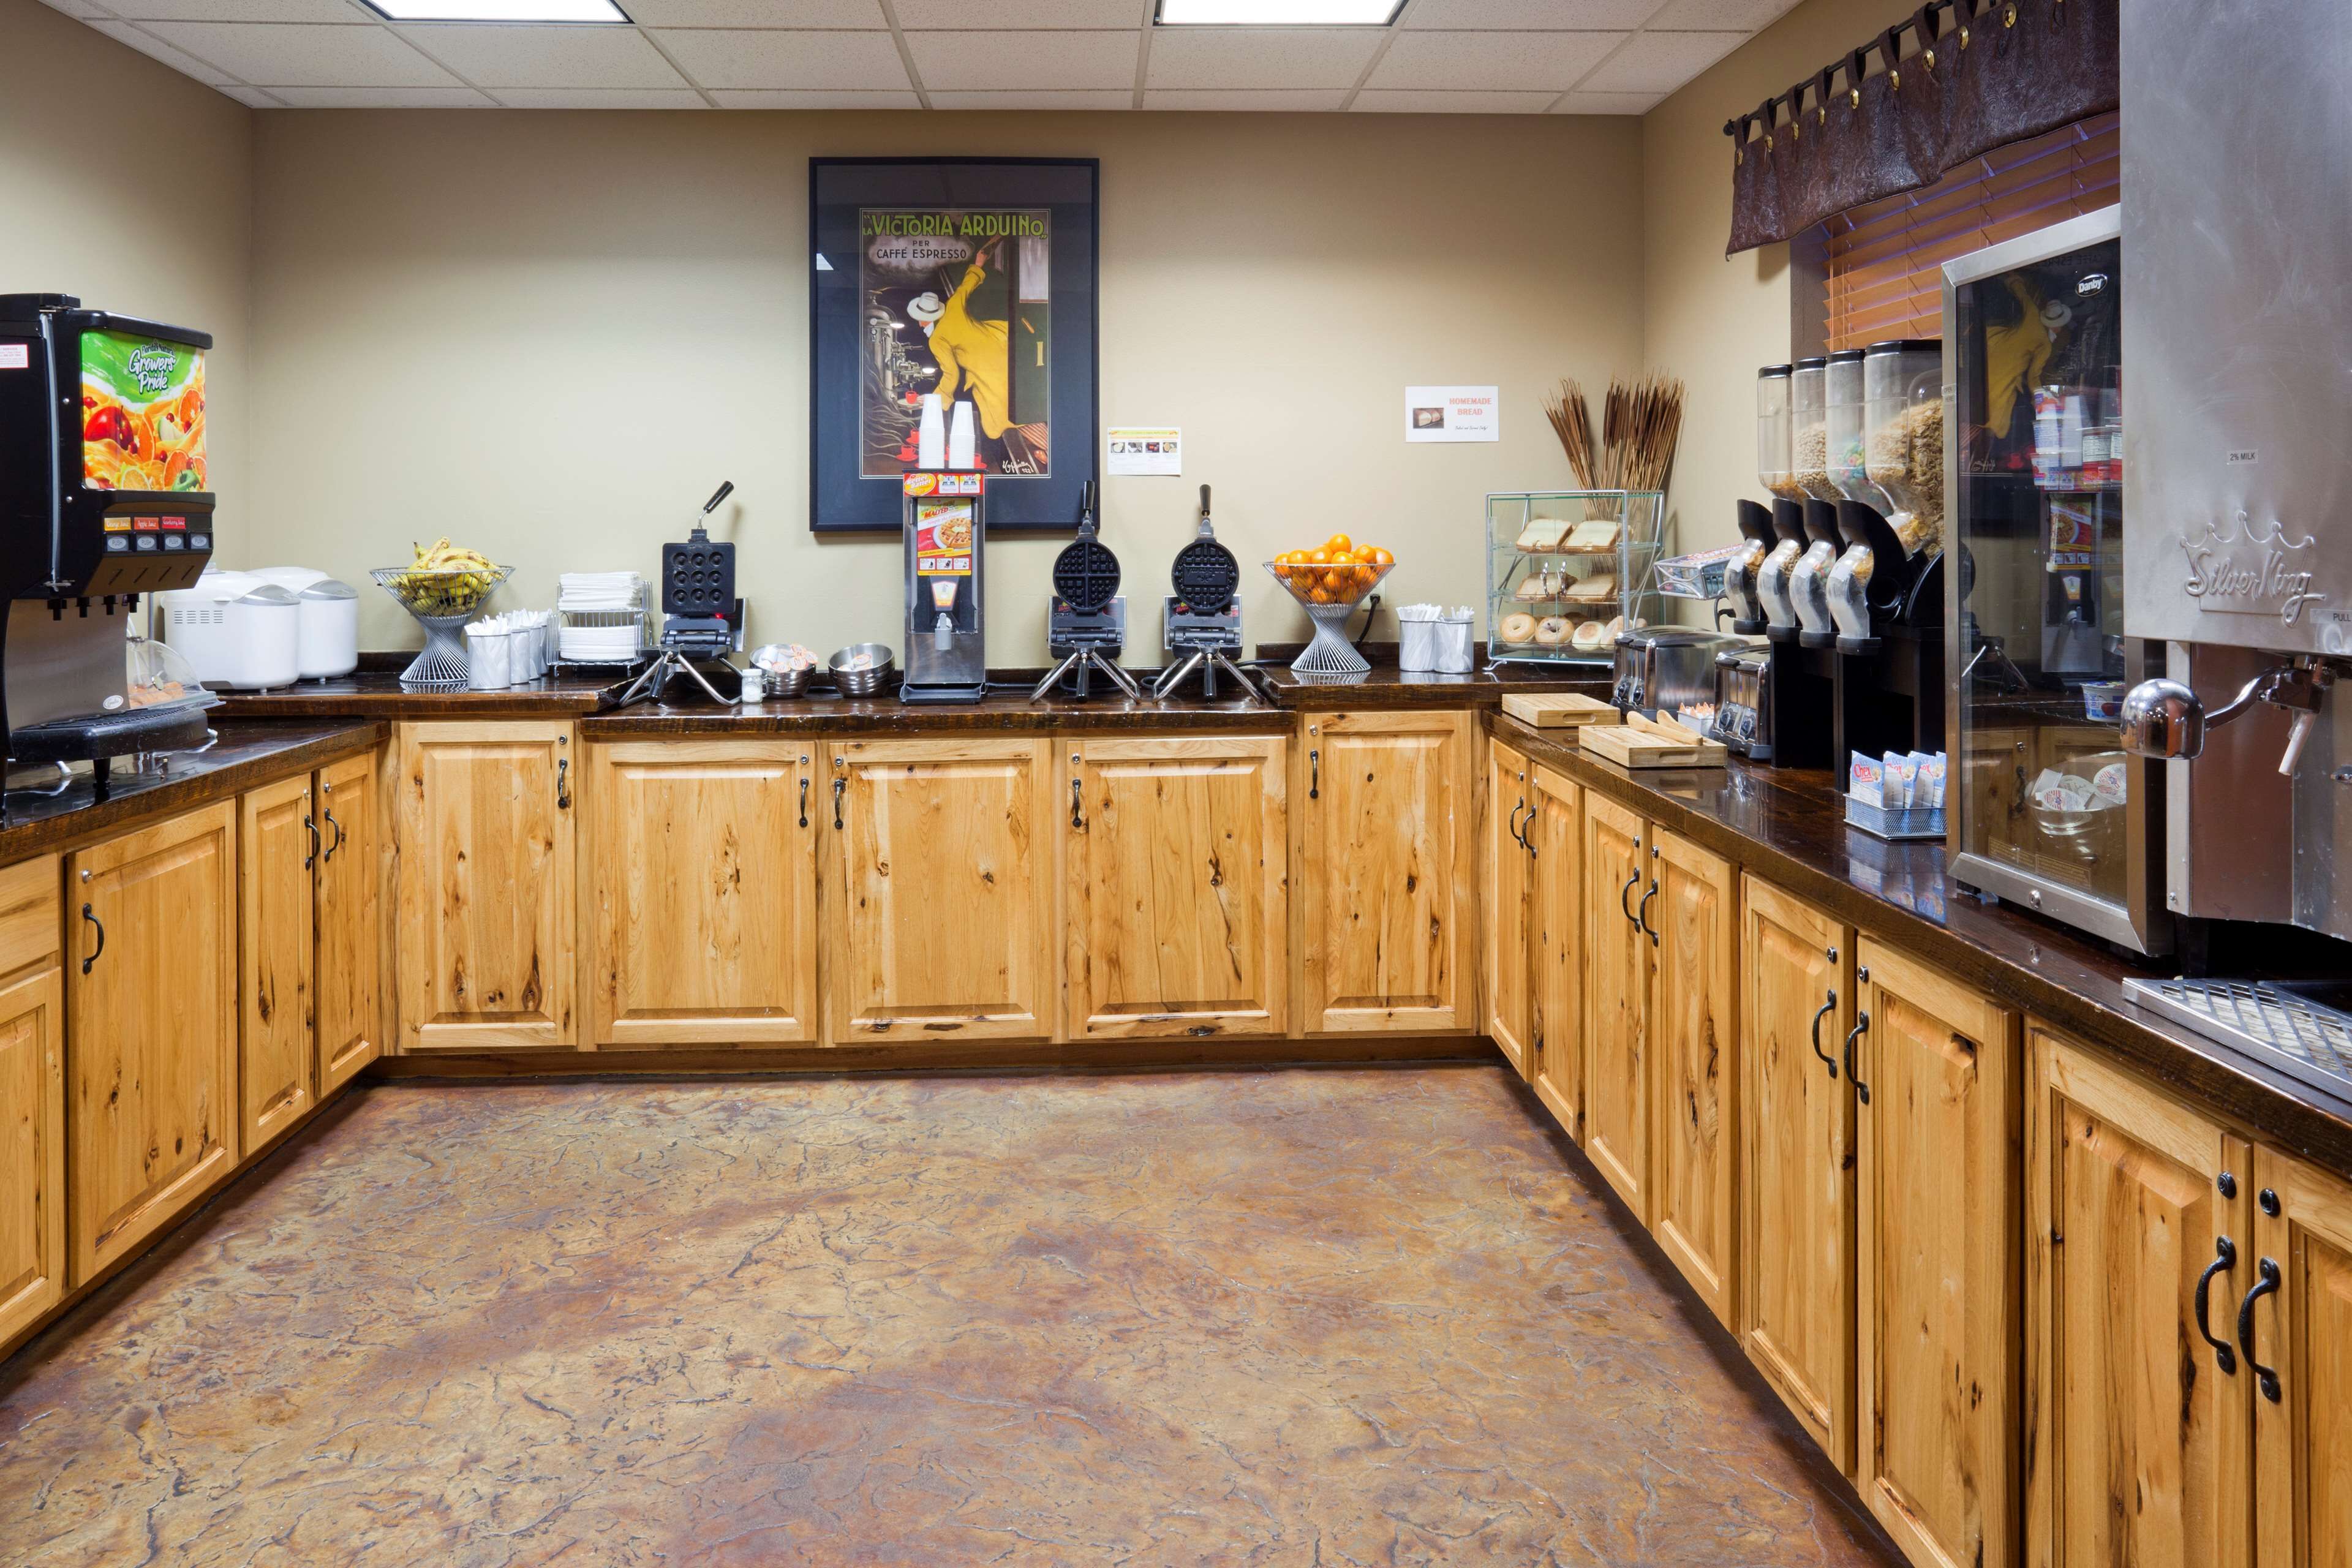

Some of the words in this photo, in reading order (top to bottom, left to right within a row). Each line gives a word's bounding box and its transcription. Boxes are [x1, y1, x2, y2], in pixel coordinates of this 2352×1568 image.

[913, 249, 967, 258] ESPRESSO
[2078, 278, 2103, 293] Danby
[137, 371, 168, 394] Pride
[924, 507, 949, 519] MALTED
[2332, 612, 2351, 622] PULL
[1853, 763, 1872, 778] Chex
